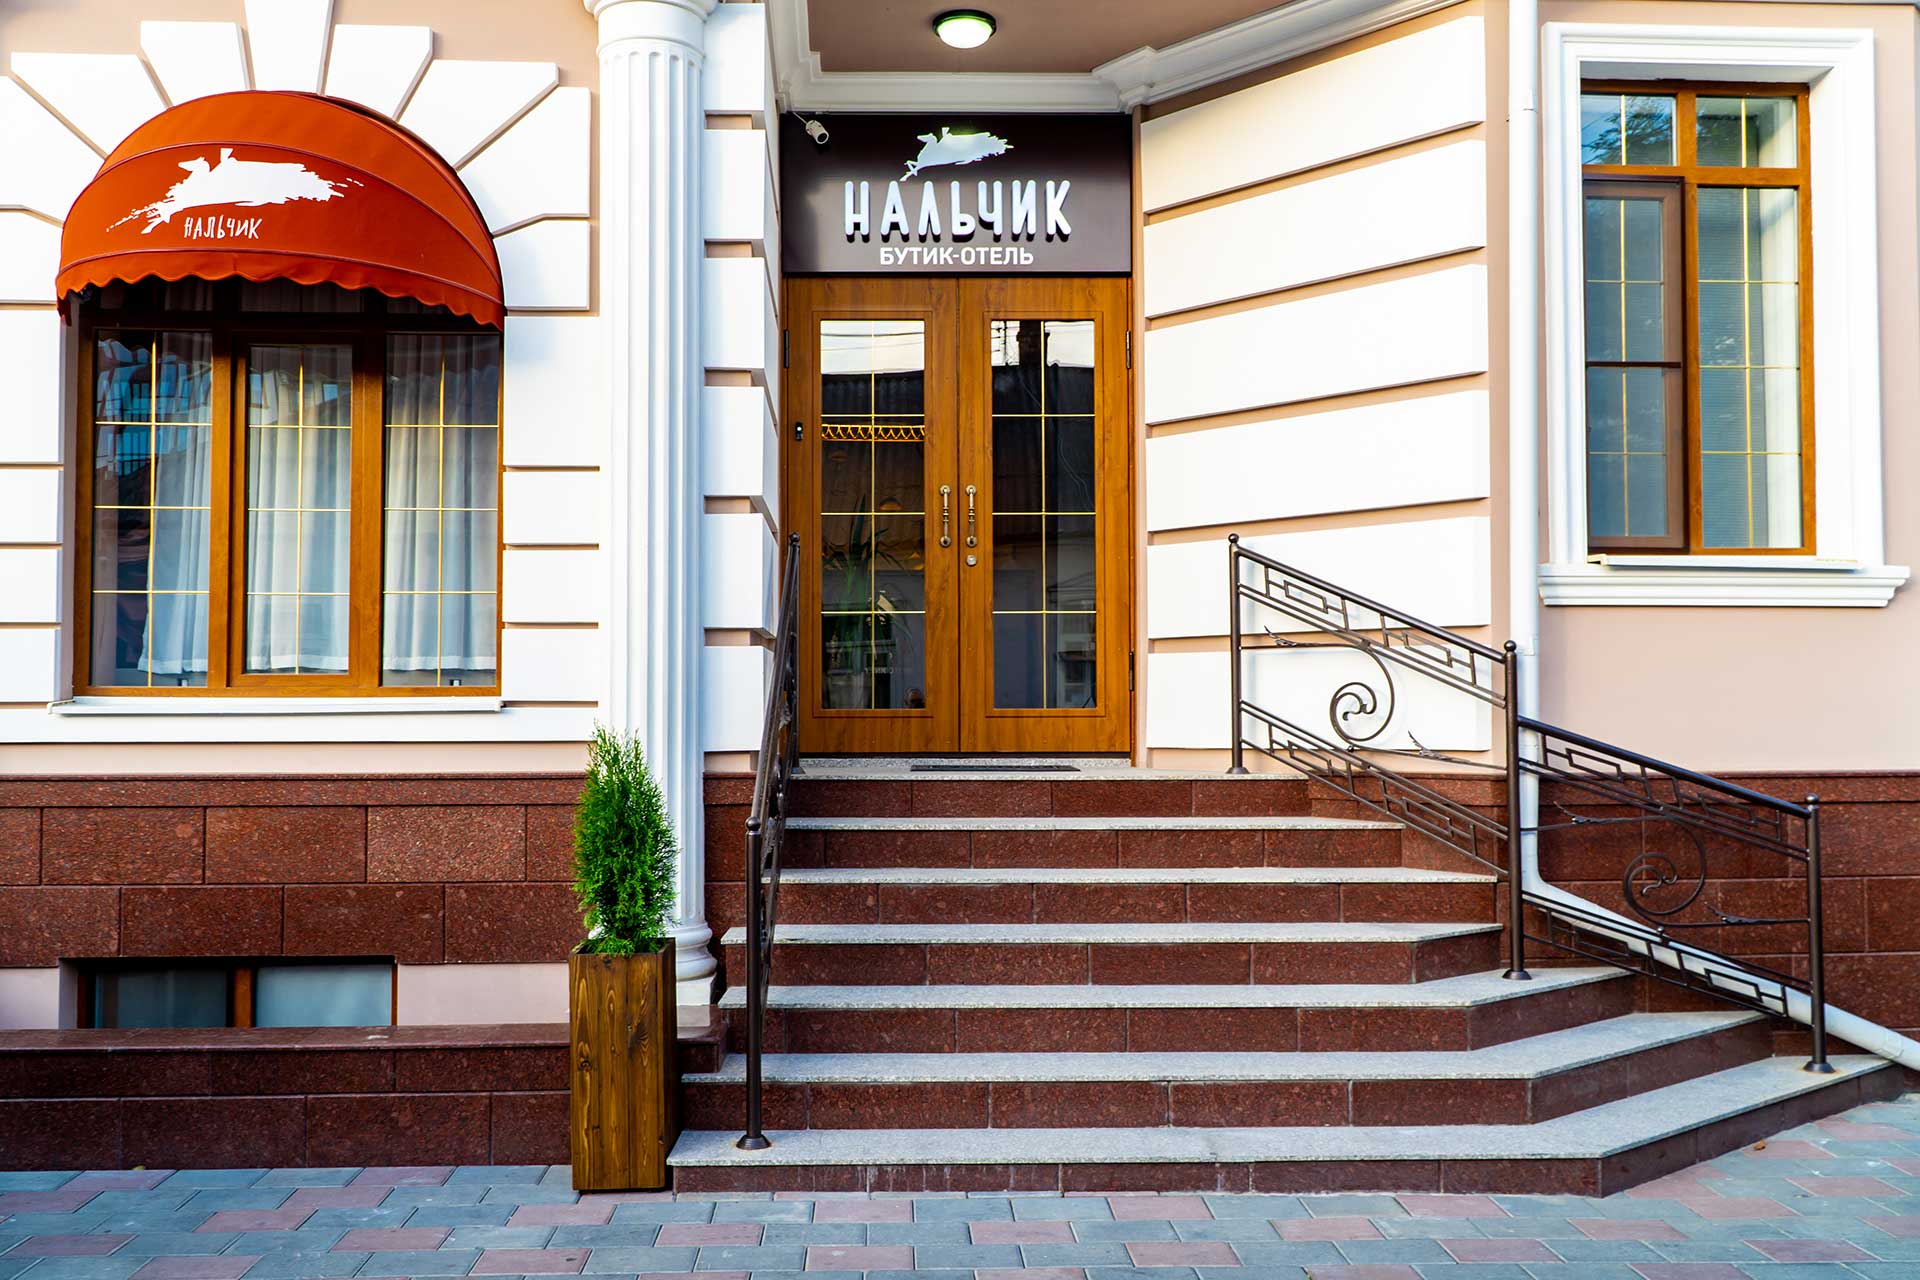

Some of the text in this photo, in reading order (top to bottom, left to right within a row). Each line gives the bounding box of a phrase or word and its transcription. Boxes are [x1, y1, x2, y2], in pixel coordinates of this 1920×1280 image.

[844, 180, 1072, 238] НАЛЬЧИК
[183, 214, 263, 240] НАЛЬЧИК
[879, 246, 1034, 265] БУТИК-ОТЕЛЬ
